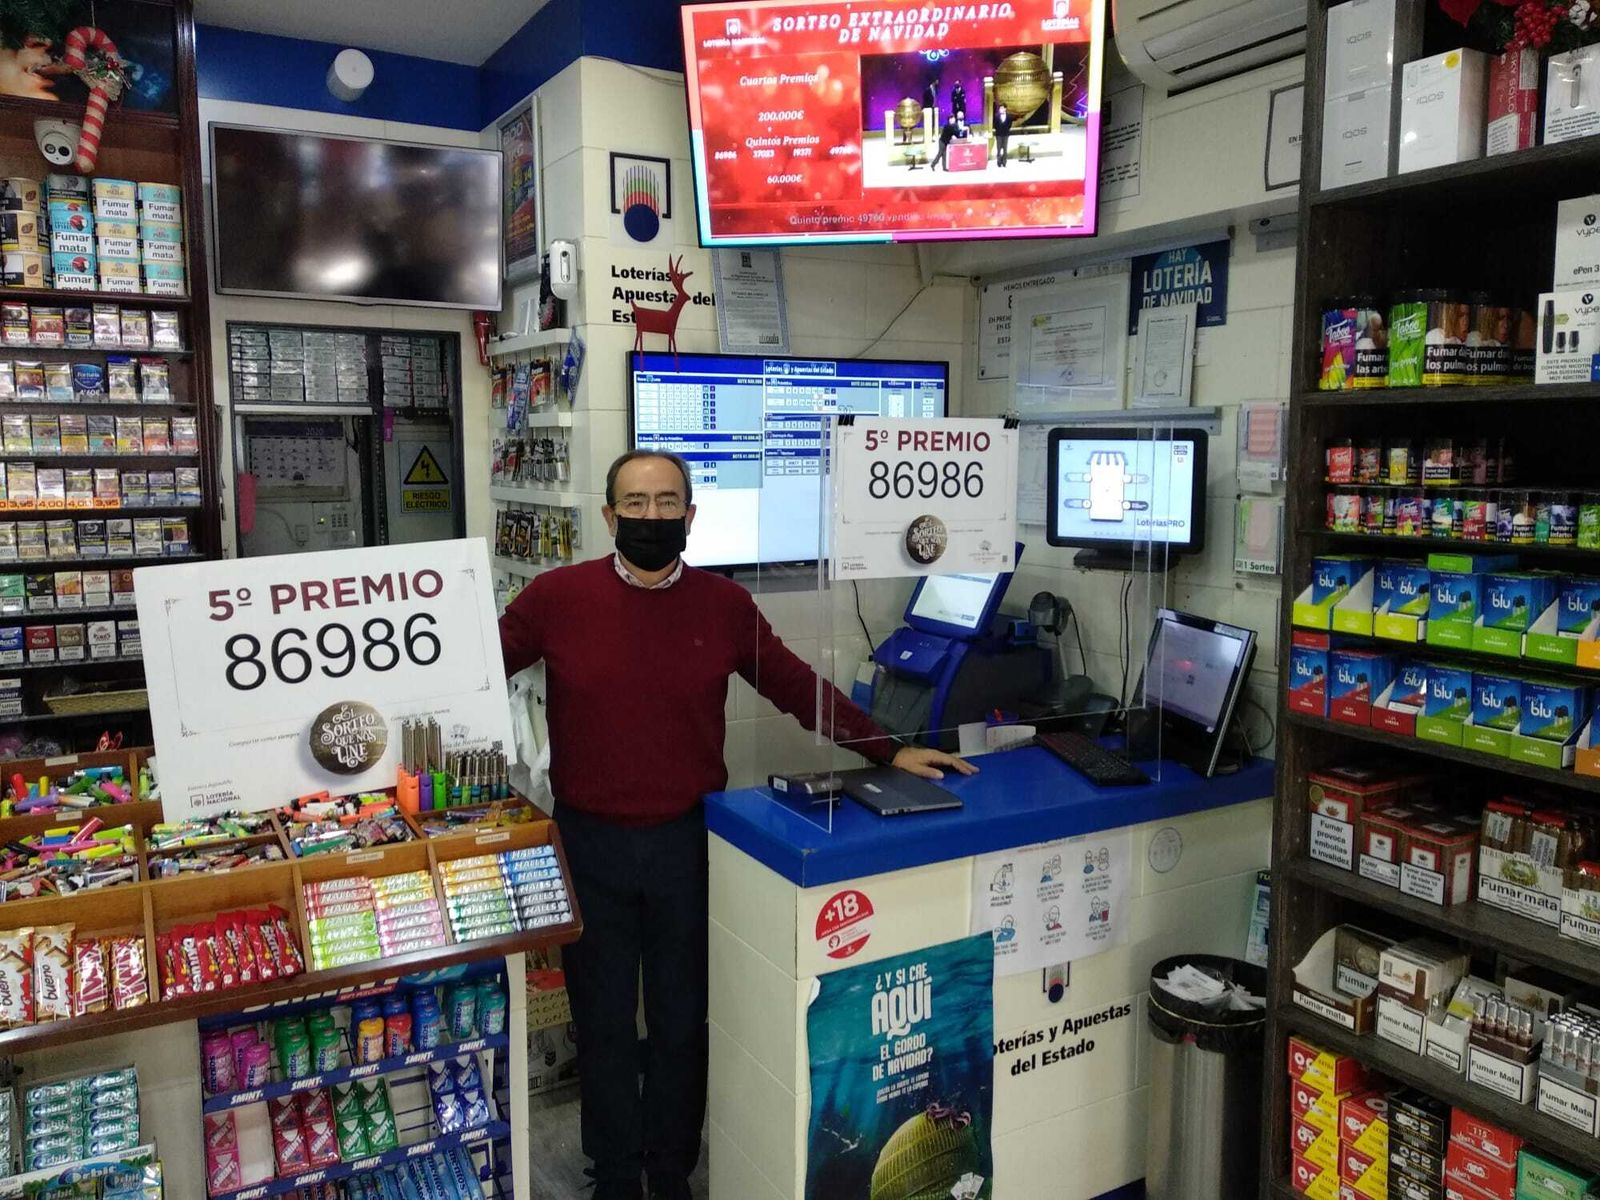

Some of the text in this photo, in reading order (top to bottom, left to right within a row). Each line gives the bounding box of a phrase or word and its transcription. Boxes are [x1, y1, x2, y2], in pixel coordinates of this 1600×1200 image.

[772, 3, 1012, 32] SORTEO EXTRAORDINARIO
[838, 23, 949, 44] DE NAVIDAD
[740, 74, 818, 86] Cuartos Premios
[758, 110, 804, 122] 200.000€
[746, 135, 819, 148] Quintos Premios
[715, 152, 737, 160] 86986
[768, 175, 802, 184] 60.000€
[102, 200, 130, 208] Fumar
[149, 203, 176, 212] Fumar
[790, 216, 820, 225] Quinto
[823, 215, 854, 224] premio
[54, 232, 90, 242] Fumar
[104, 239, 132, 247] Fumar
[59, 244, 87, 253] mata
[149, 242, 176, 250] Fumar
[1168, 250, 1188, 263] HAY
[612, 265, 672, 282] Loterías
[1144, 255, 1212, 292] LOTERÍA
[1574, 266, 1592, 274] ePen
[612, 287, 716, 306] Apuesta del
[1160, 287, 1212, 308] NAVIDAD
[1358, 353, 1384, 362] Fumar
[1427, 348, 1457, 357] Fumar
[1356, 364, 1370, 373] las
[1426, 360, 1441, 368] los
[865, 430, 990, 452] 5º PREMIO
[868, 461, 984, 498] 86986
[1250, 562, 1274, 572] Sorteo
[208, 569, 442, 622] 5º PREMIO
[1438, 589, 1456, 604] blu
[1492, 594, 1510, 608] blu
[1568, 596, 1588, 612] blu
[224, 612, 441, 691] 86986
[1296, 662, 1311, 676] blu
[1339, 669, 1355, 684] blu
[1434, 684, 1452, 700] blu
[1482, 692, 1500, 708] blu
[1530, 701, 1551, 718] blu
[206, 790, 234, 800] LOTERÍA
[206, 796, 241, 805] NACIONAL
[1320, 820, 1343, 832] Fumar
[1317, 831, 1346, 844] provoca
[512, 848, 542, 858] HALLS
[1315, 840, 1348, 854] embolias
[514, 860, 544, 869] HALLS
[1318, 851, 1350, 866] invalidez
[518, 870, 548, 880] HALLS
[320, 878, 356, 891] HALLS
[522, 892, 553, 902] HALLS
[1481, 880, 1558, 912] Fumar mata
[825, 894, 859, 921] +18
[527, 914, 560, 926] HALLS
[1563, 914, 1600, 935] Fumar
[896, 970, 906, 986] SI
[910, 962, 928, 982] CAE
[43, 964, 58, 1000] bueno
[1338, 972, 1369, 992] Fumar
[872, 976, 932, 1040] AQUÍ
[1300, 996, 1346, 1022] Fumar mata
[454, 1002, 462, 1038] mentos
[1378, 1012, 1420, 1036] Fumar Mata
[993, 1003, 1130, 1056] oterías y Apuestas
[458, 1039, 486, 1052] SMINT
[880, 1033, 926, 1060] EL GORDO
[405, 1051, 434, 1064] SMINT
[1011, 1038, 1095, 1076] del Estado
[350, 1064, 380, 1076] SMINT
[873, 1048, 934, 1081] DE NAVIDAD?
[1471, 1058, 1520, 1086] Fumar Mata
[291, 1076, 323, 1090] SMINT
[230, 1090, 264, 1104] SMINT
[1540, 1088, 1593, 1118] Fumar Mata
[460, 1128, 488, 1142] SMINT
[1473, 1127, 1488, 1138] 115
[352, 1156, 382, 1170] SMINT
[448, 1150, 466, 1190] mentos
[70, 1165, 116, 1181] Orbit
